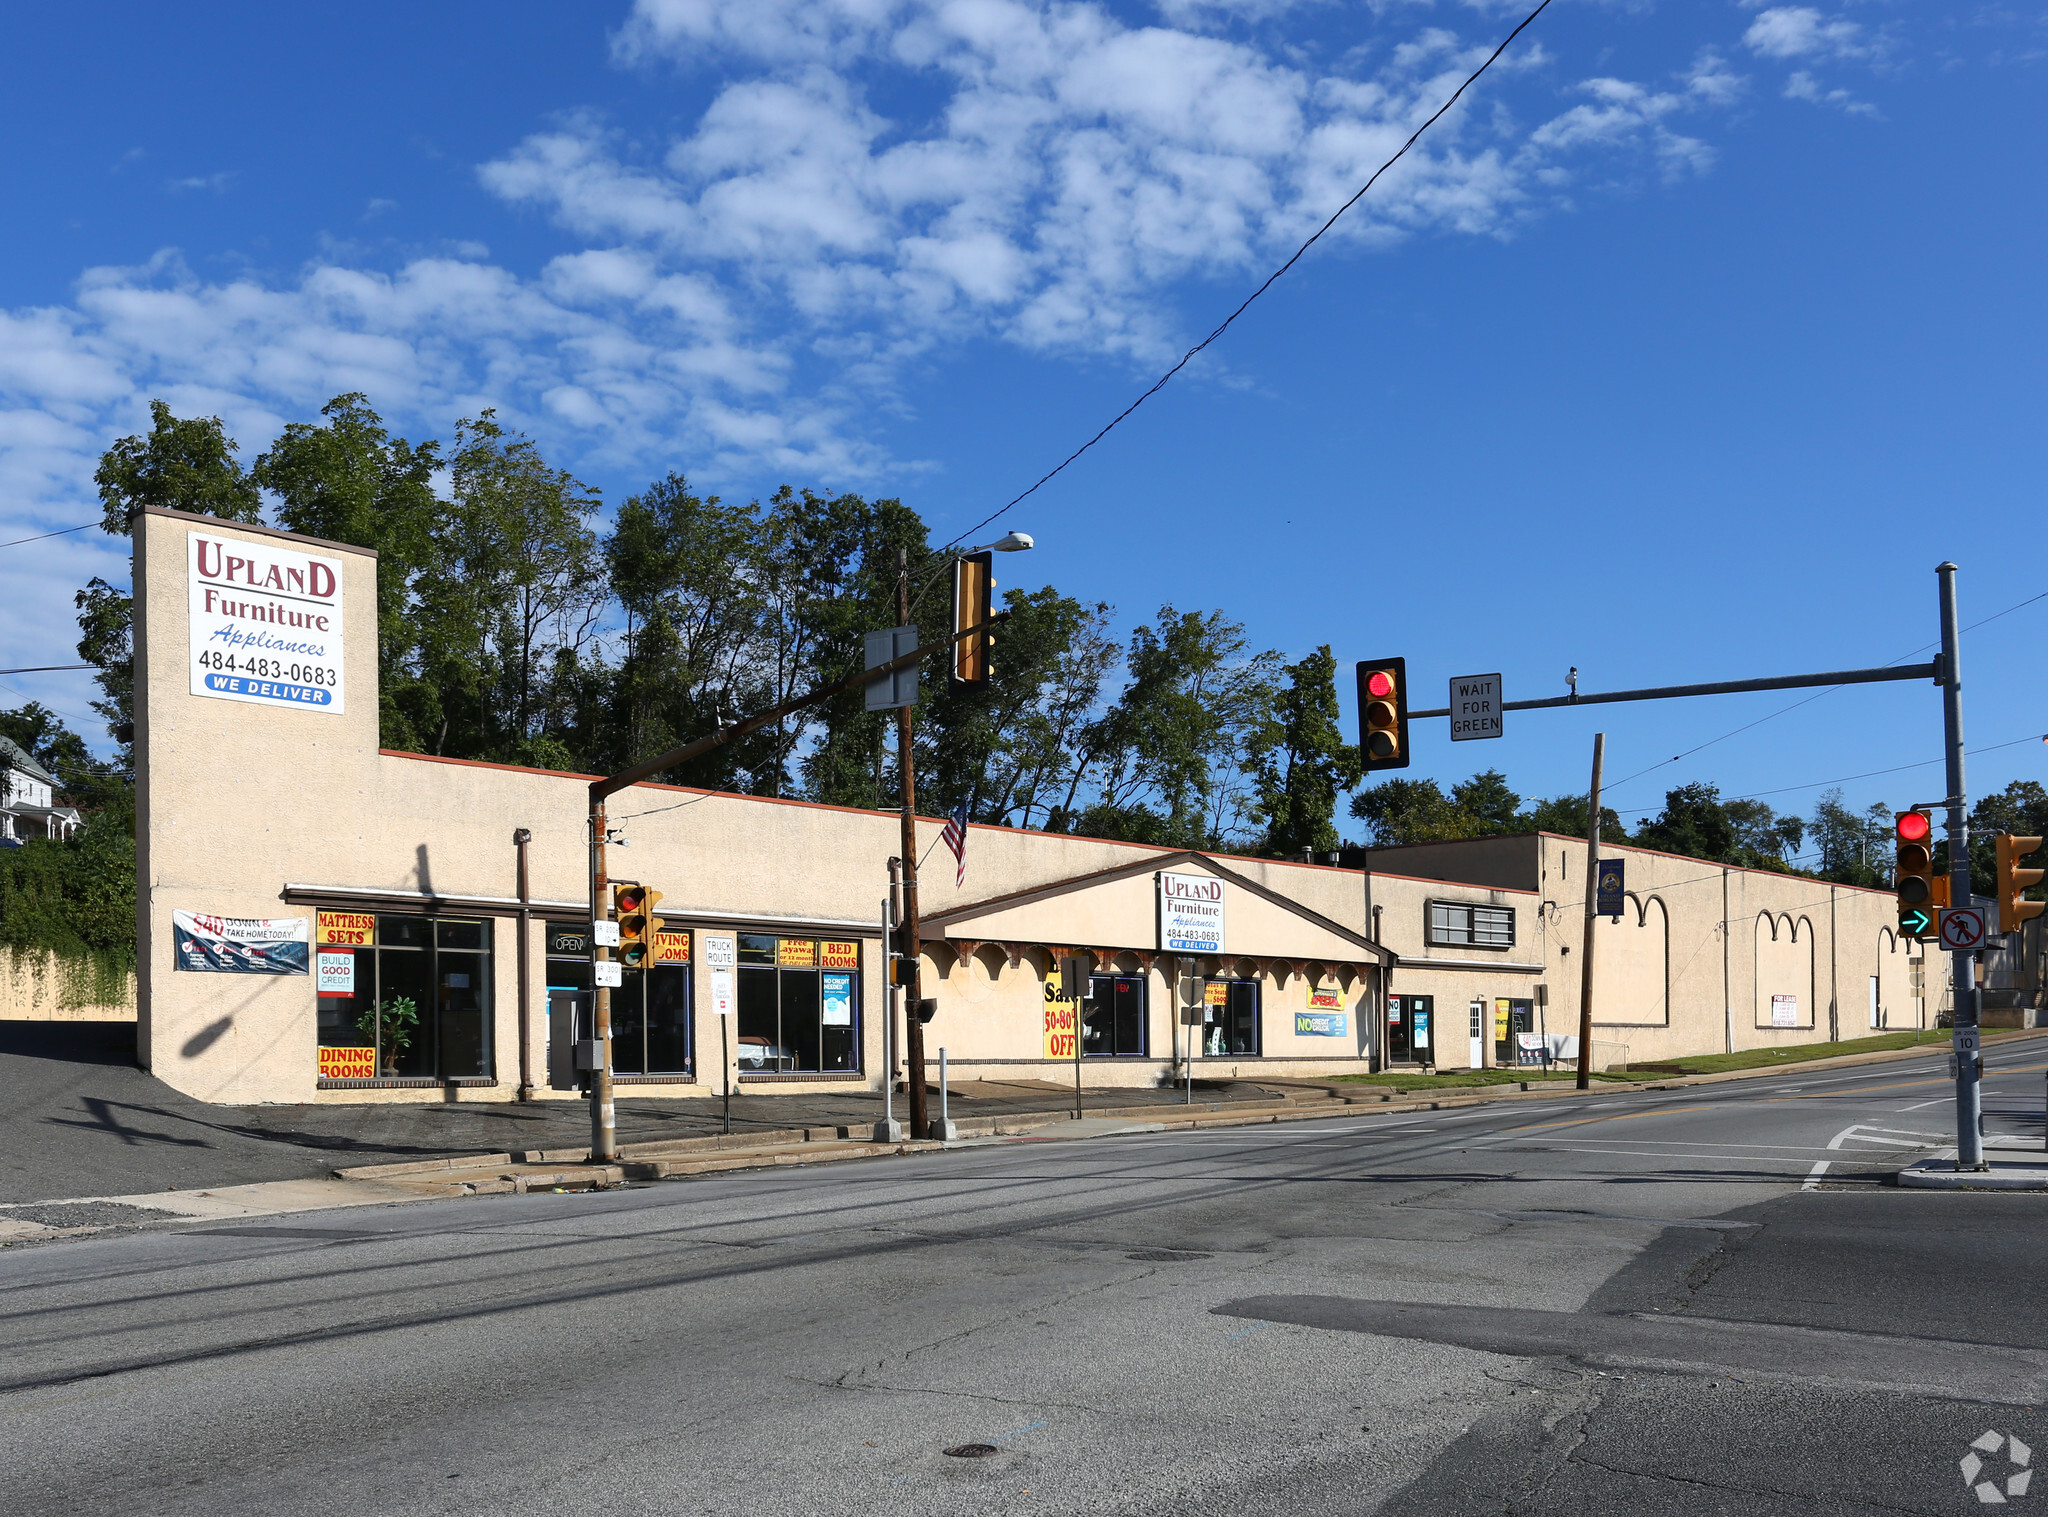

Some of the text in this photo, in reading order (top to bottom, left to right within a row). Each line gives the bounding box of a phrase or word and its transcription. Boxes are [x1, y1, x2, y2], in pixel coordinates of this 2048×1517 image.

[196, 539, 336, 598] UPLAND
[204, 589, 329, 632] Furniture
[210, 623, 326, 657] Appliances
[199, 650, 336, 686] 484-483-0683
[213, 676, 324, 703] WE DELIVER
[1459, 683, 1492, 697] WAIT
[1463, 701, 1490, 715] FOR
[1453, 717, 1499, 733] GREEN
[1164, 876, 1222, 900] UPLAND
[1167, 899, 1220, 917] Furniture
[318, 913, 375, 929] MATTRESS
[1171, 914, 1216, 928] Appliances
[226, 929, 294, 939] TAKE HOME TODAY!
[327, 930, 364, 944] SETS
[655, 934, 689, 946] IVING
[1167, 928, 1220, 942] 484-483-0683
[556, 938, 582, 950] OPEN
[707, 940, 732, 951] TRUCK
[828, 943, 852, 954] BED
[1172, 940, 1216, 950] WE DELIVER
[322, 956, 351, 965] BUILD
[659, 948, 688, 960] OMS
[707, 953, 732, 963] ROUTE
[822, 956, 857, 968] ROOMS
[322, 966, 351, 975] GOOD
[321, 976, 351, 984] CREDIT
[1389, 1001, 1399, 1010] NO
[1297, 1018, 1312, 1032] NO
[1050, 1034, 1076, 1056] OFF
[1960, 1038, 1973, 1049] 10
[320, 1049, 374, 1062] DINING
[320, 1065, 373, 1078] ROOMS
